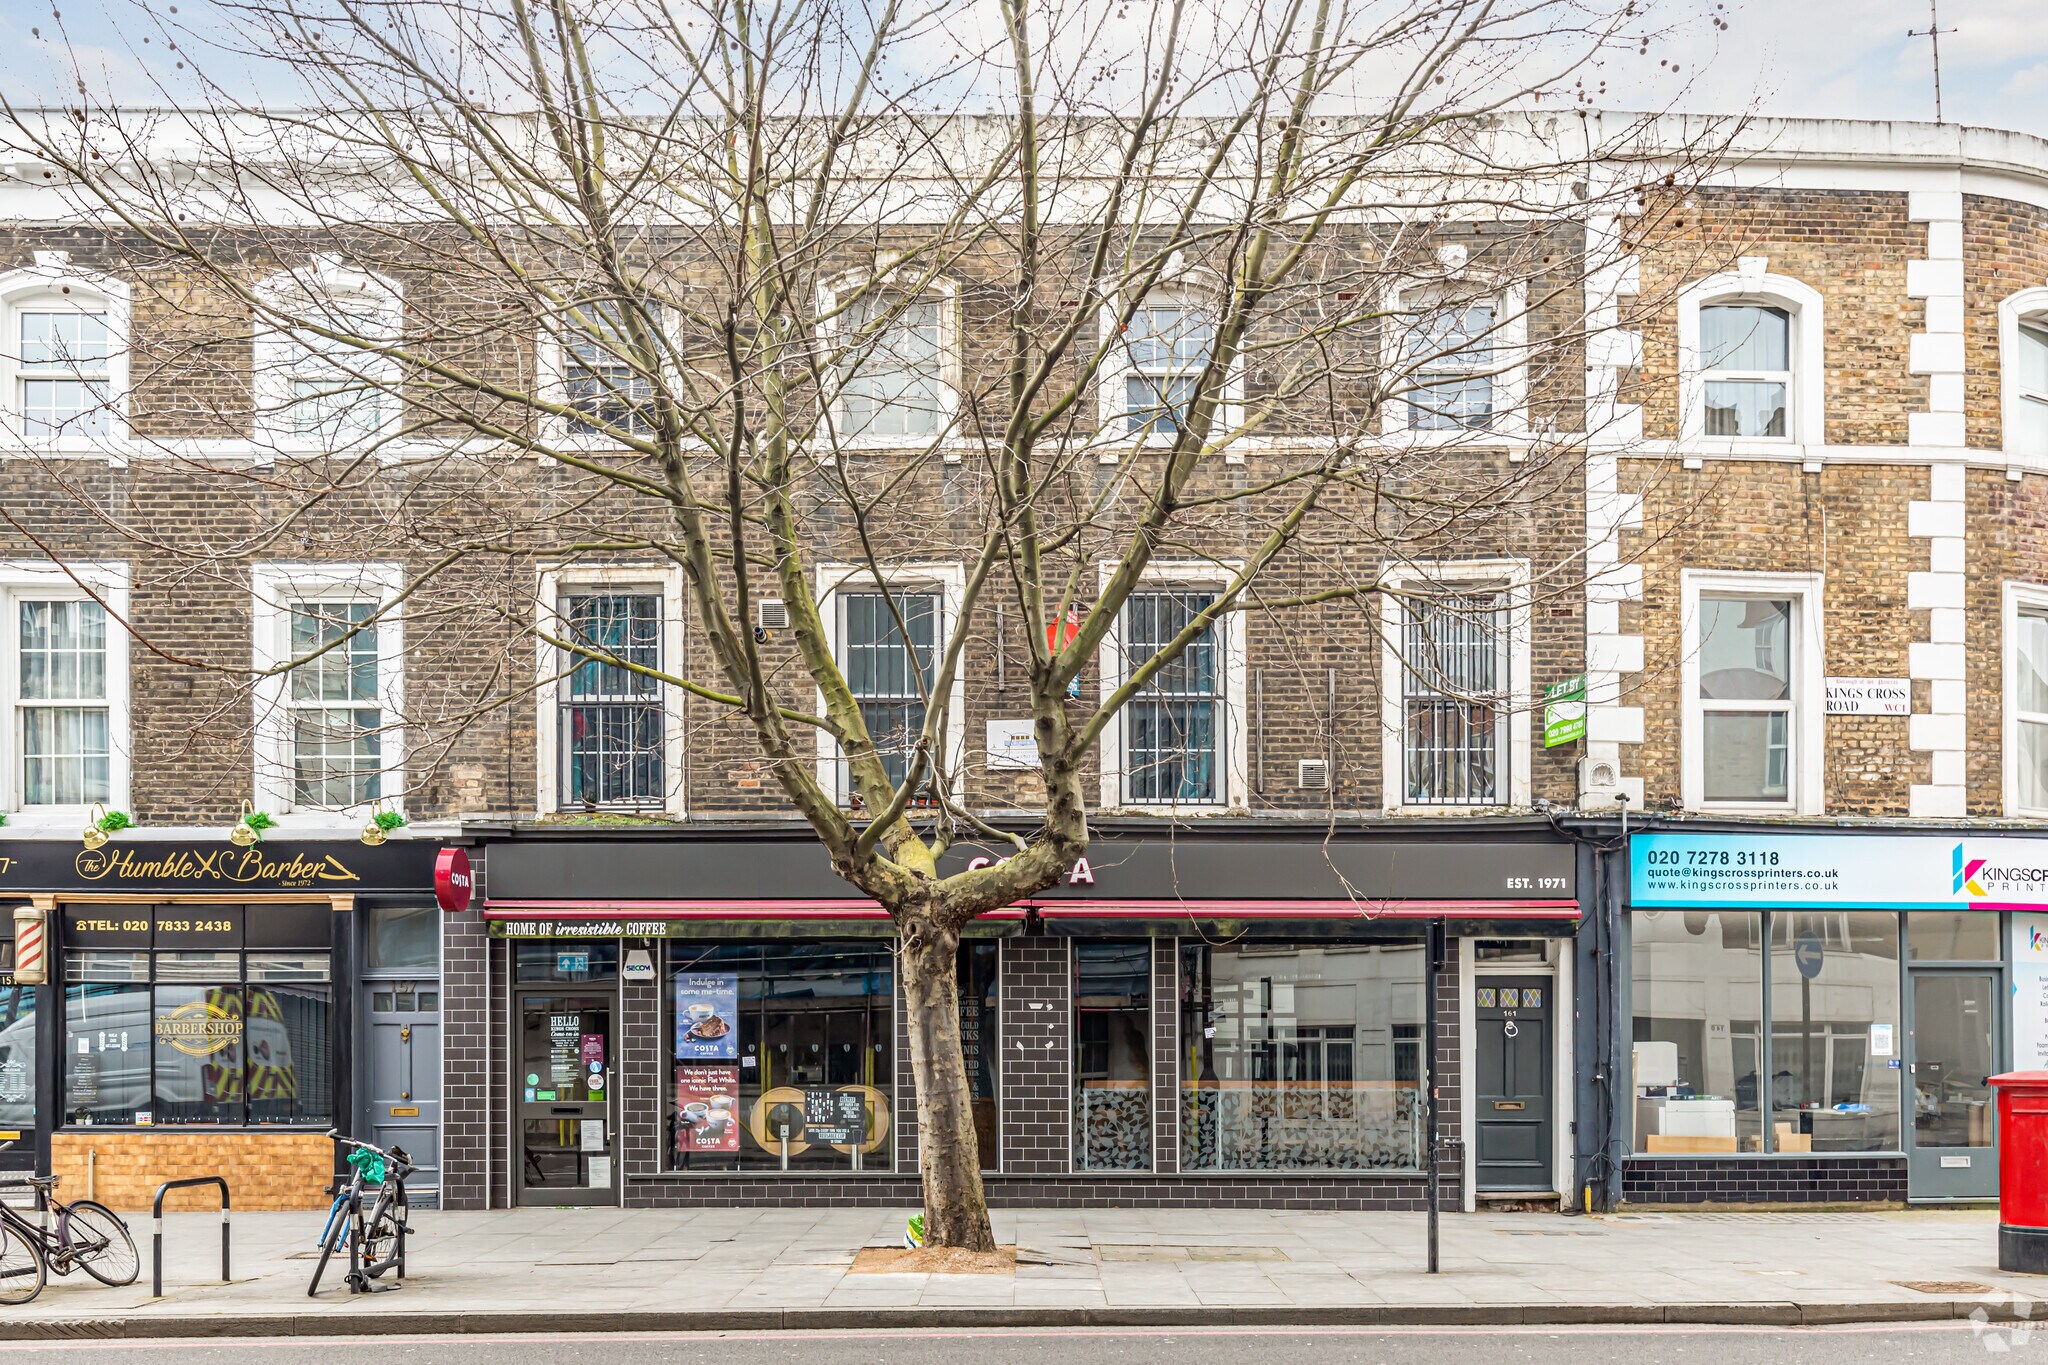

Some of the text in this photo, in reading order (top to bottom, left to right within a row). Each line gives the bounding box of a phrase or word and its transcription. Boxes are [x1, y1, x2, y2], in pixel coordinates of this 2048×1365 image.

[1551, 677, 1580, 698] LET BY
[1826, 687, 1906, 699] KINGS CROSS
[1826, 700, 1906, 712] ROAD WC1
[1648, 850, 1780, 866] 020 7278 3118
[79, 850, 326, 882] The Humble Barber
[1648, 867, 1839, 879] quote@kingscrossprinters.co.uk
[451, 872, 469, 888] COSTA
[1507, 878, 1566, 889] EST. 1971
[1648, 880, 1839, 891] www.kingscrossprinters.co.uk
[88, 920, 232, 932] TEL: 020 7833 2438
[506, 922, 667, 936] HOME OF irresistible COFFEE
[626, 964, 651, 972] SECOM
[689, 978, 724, 988] Indulge in
[550, 1016, 580, 1027] HELLO
[961, 1021, 979, 1030] COLD
[155, 1022, 243, 1035] BARBERSHOP
[962, 1045, 979, 1055] NIS
[707, 1069, 718, 1077] just
